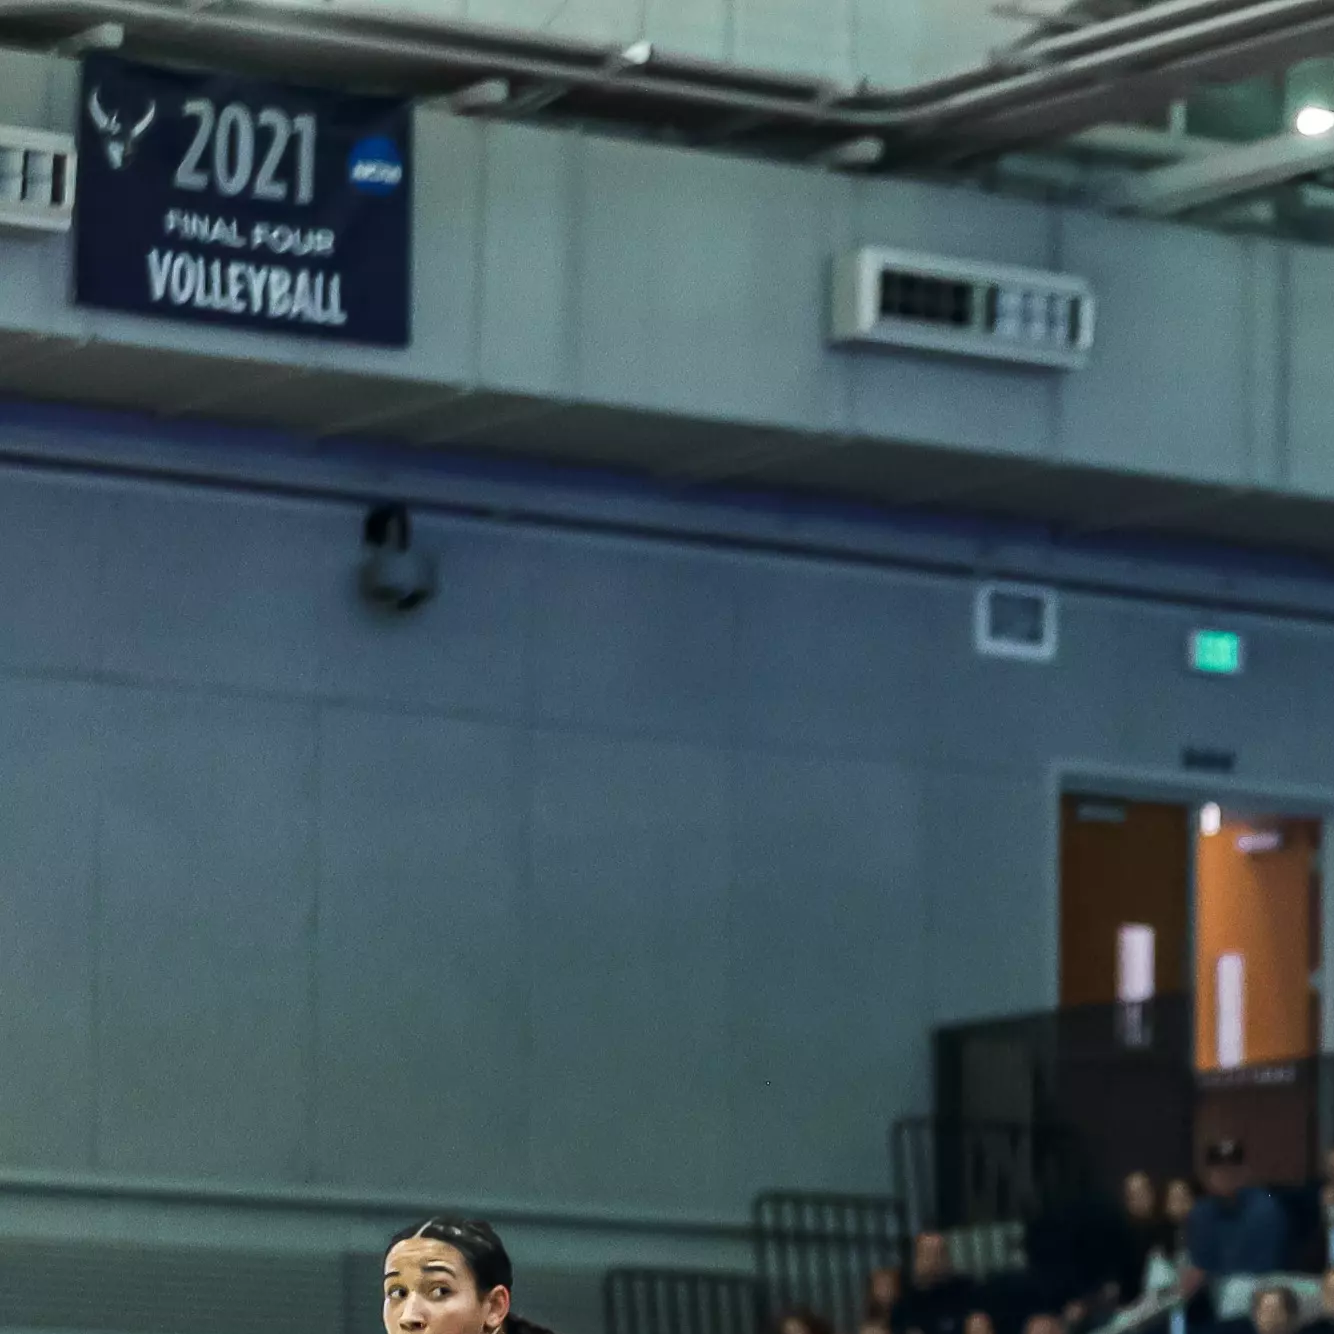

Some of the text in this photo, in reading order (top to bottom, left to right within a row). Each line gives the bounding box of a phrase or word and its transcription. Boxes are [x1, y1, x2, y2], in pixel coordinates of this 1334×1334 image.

[175, 98, 316, 204] 2021
[165, 209, 336, 255] FINAL FOUR
[146, 248, 348, 326] VOLLEYBALL
